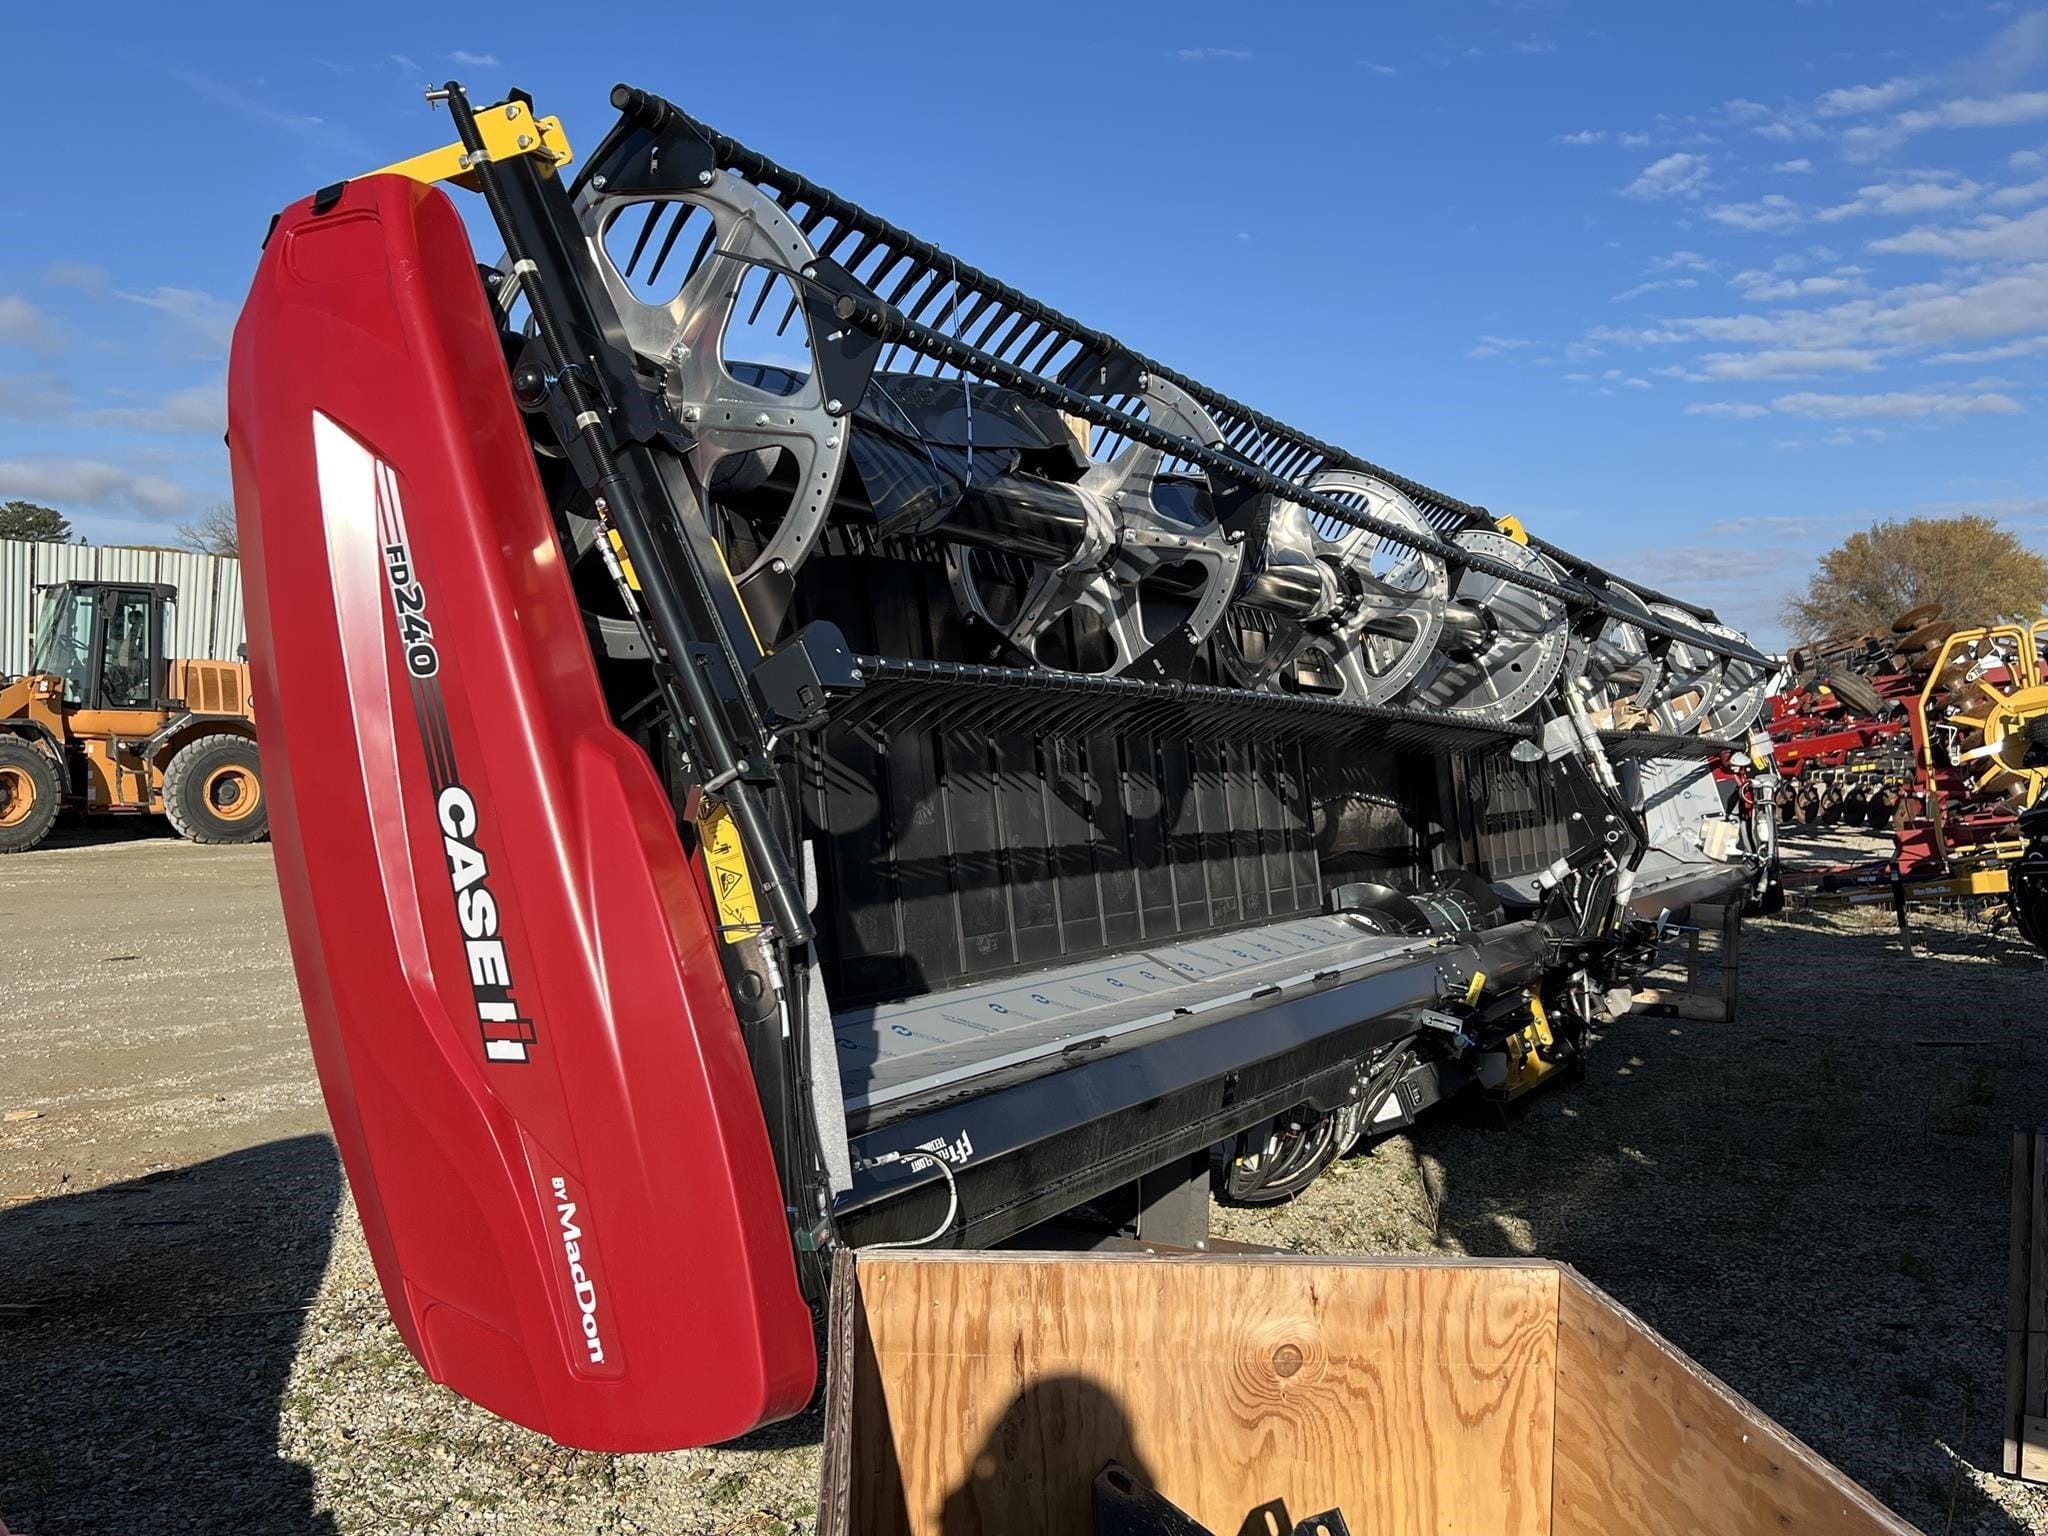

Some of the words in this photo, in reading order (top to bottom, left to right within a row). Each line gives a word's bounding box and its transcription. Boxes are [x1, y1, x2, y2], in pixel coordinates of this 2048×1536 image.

[385, 544, 440, 679] FD240
[438, 785, 512, 986] CASE
[551, 1176, 568, 1201] BY
[556, 1202, 605, 1363] MacDon
